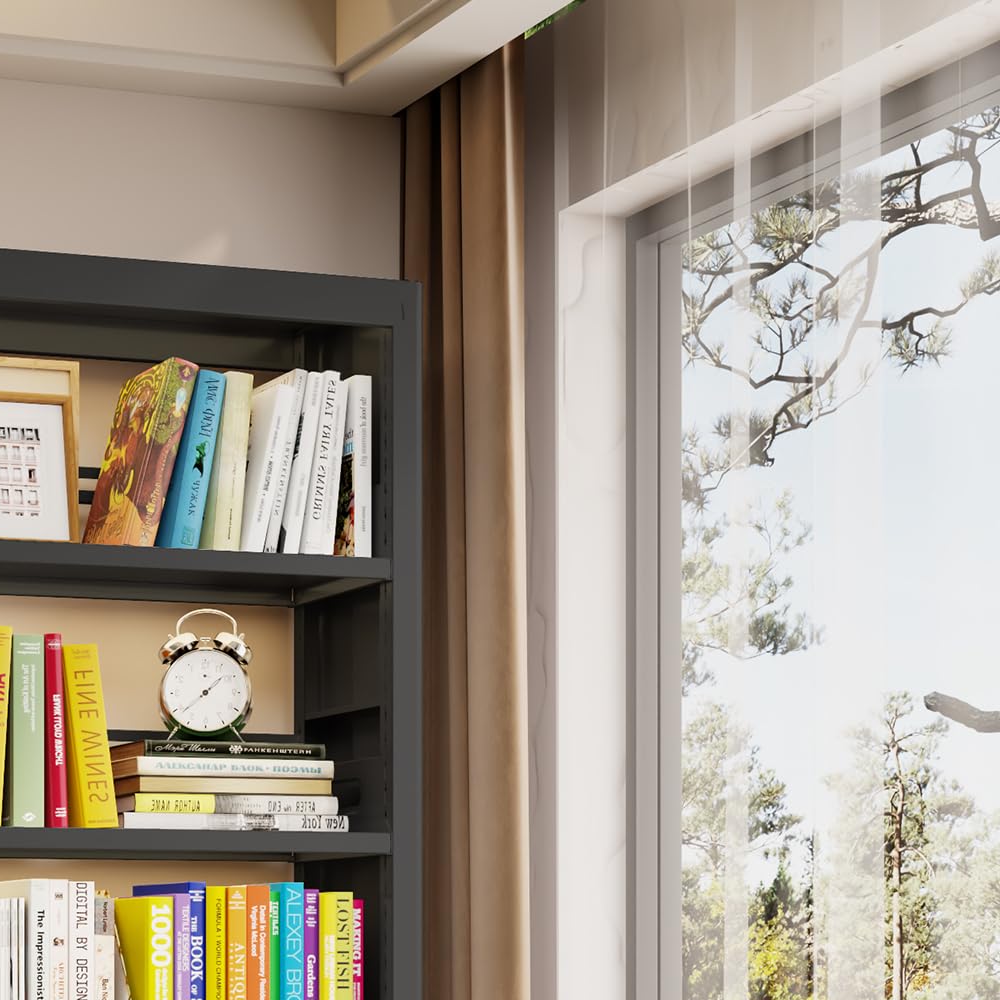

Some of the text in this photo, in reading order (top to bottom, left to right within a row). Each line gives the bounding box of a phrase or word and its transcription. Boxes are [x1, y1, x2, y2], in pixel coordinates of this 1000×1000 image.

[188, 480, 200, 516] ЧУЖАК
[155, 761, 323, 775] АЛЕКСАНДР БЛОК ПОЭМЫ
[37, 910, 46, 928] The
[76, 882, 88, 929] DIGITAL
[190, 916, 198, 933] THE
[286, 887, 302, 963] ALEXEY
[76, 937, 88, 951] BY
[151, 904, 171, 967] 1000
[337, 898, 349, 989] LOST FISH
[353, 908, 361, 960] MAKING
[190, 936, 203, 981] BOOK
[307, 954, 317, 998] Gardens
[353, 963, 361, 977] IT
[190, 984, 198, 996] OF
